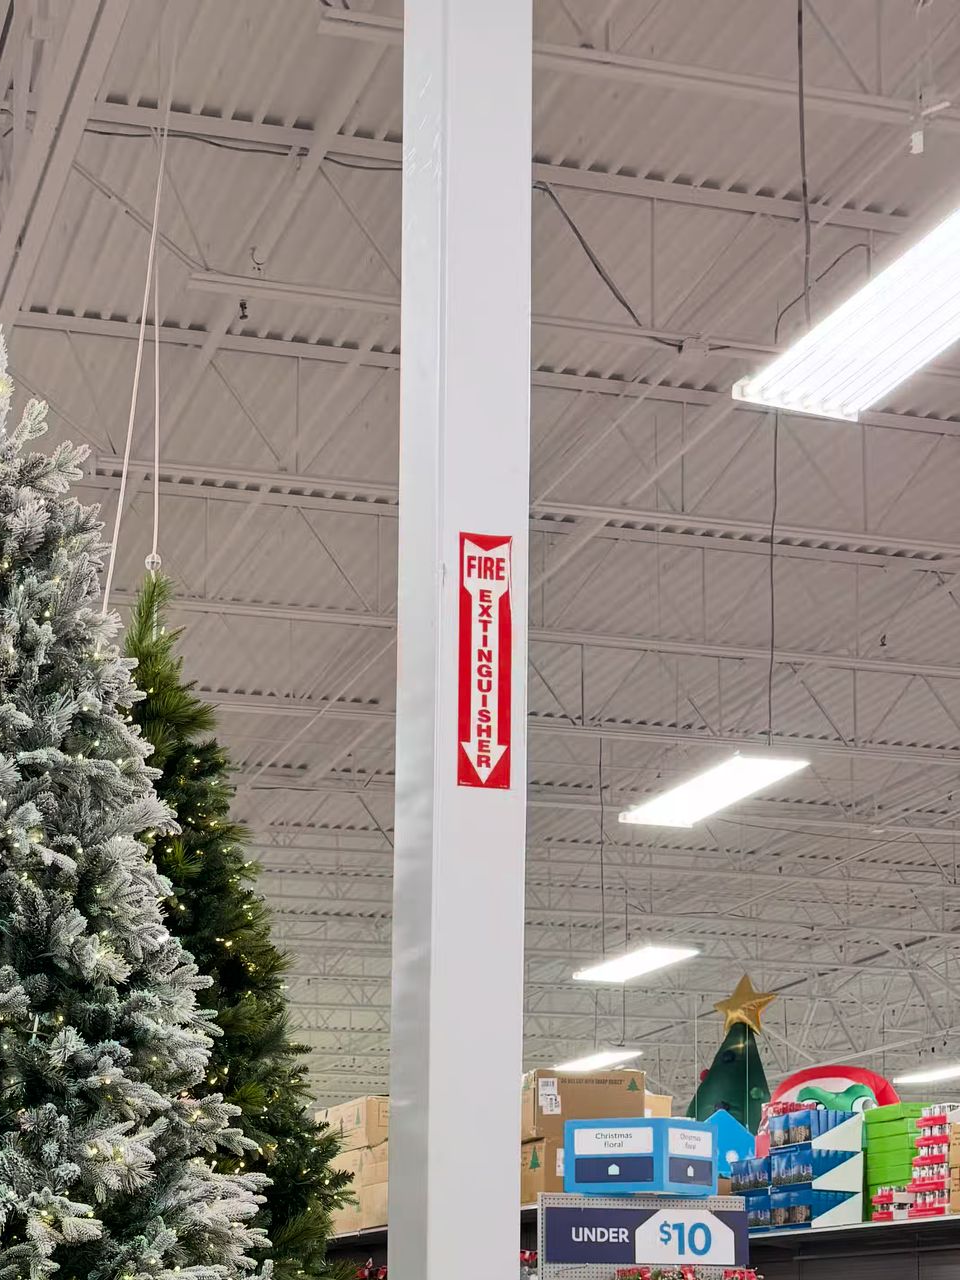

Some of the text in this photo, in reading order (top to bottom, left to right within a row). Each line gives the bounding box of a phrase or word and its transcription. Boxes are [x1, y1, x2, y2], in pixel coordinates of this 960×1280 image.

[466, 555, 506, 582] FIRE
[476, 588, 493, 769] EXTINGUISHER
[594, 1131, 633, 1141] Christmas
[603, 1140, 624, 1149] floral
[571, 1220, 712, 1256] UNDER $10
